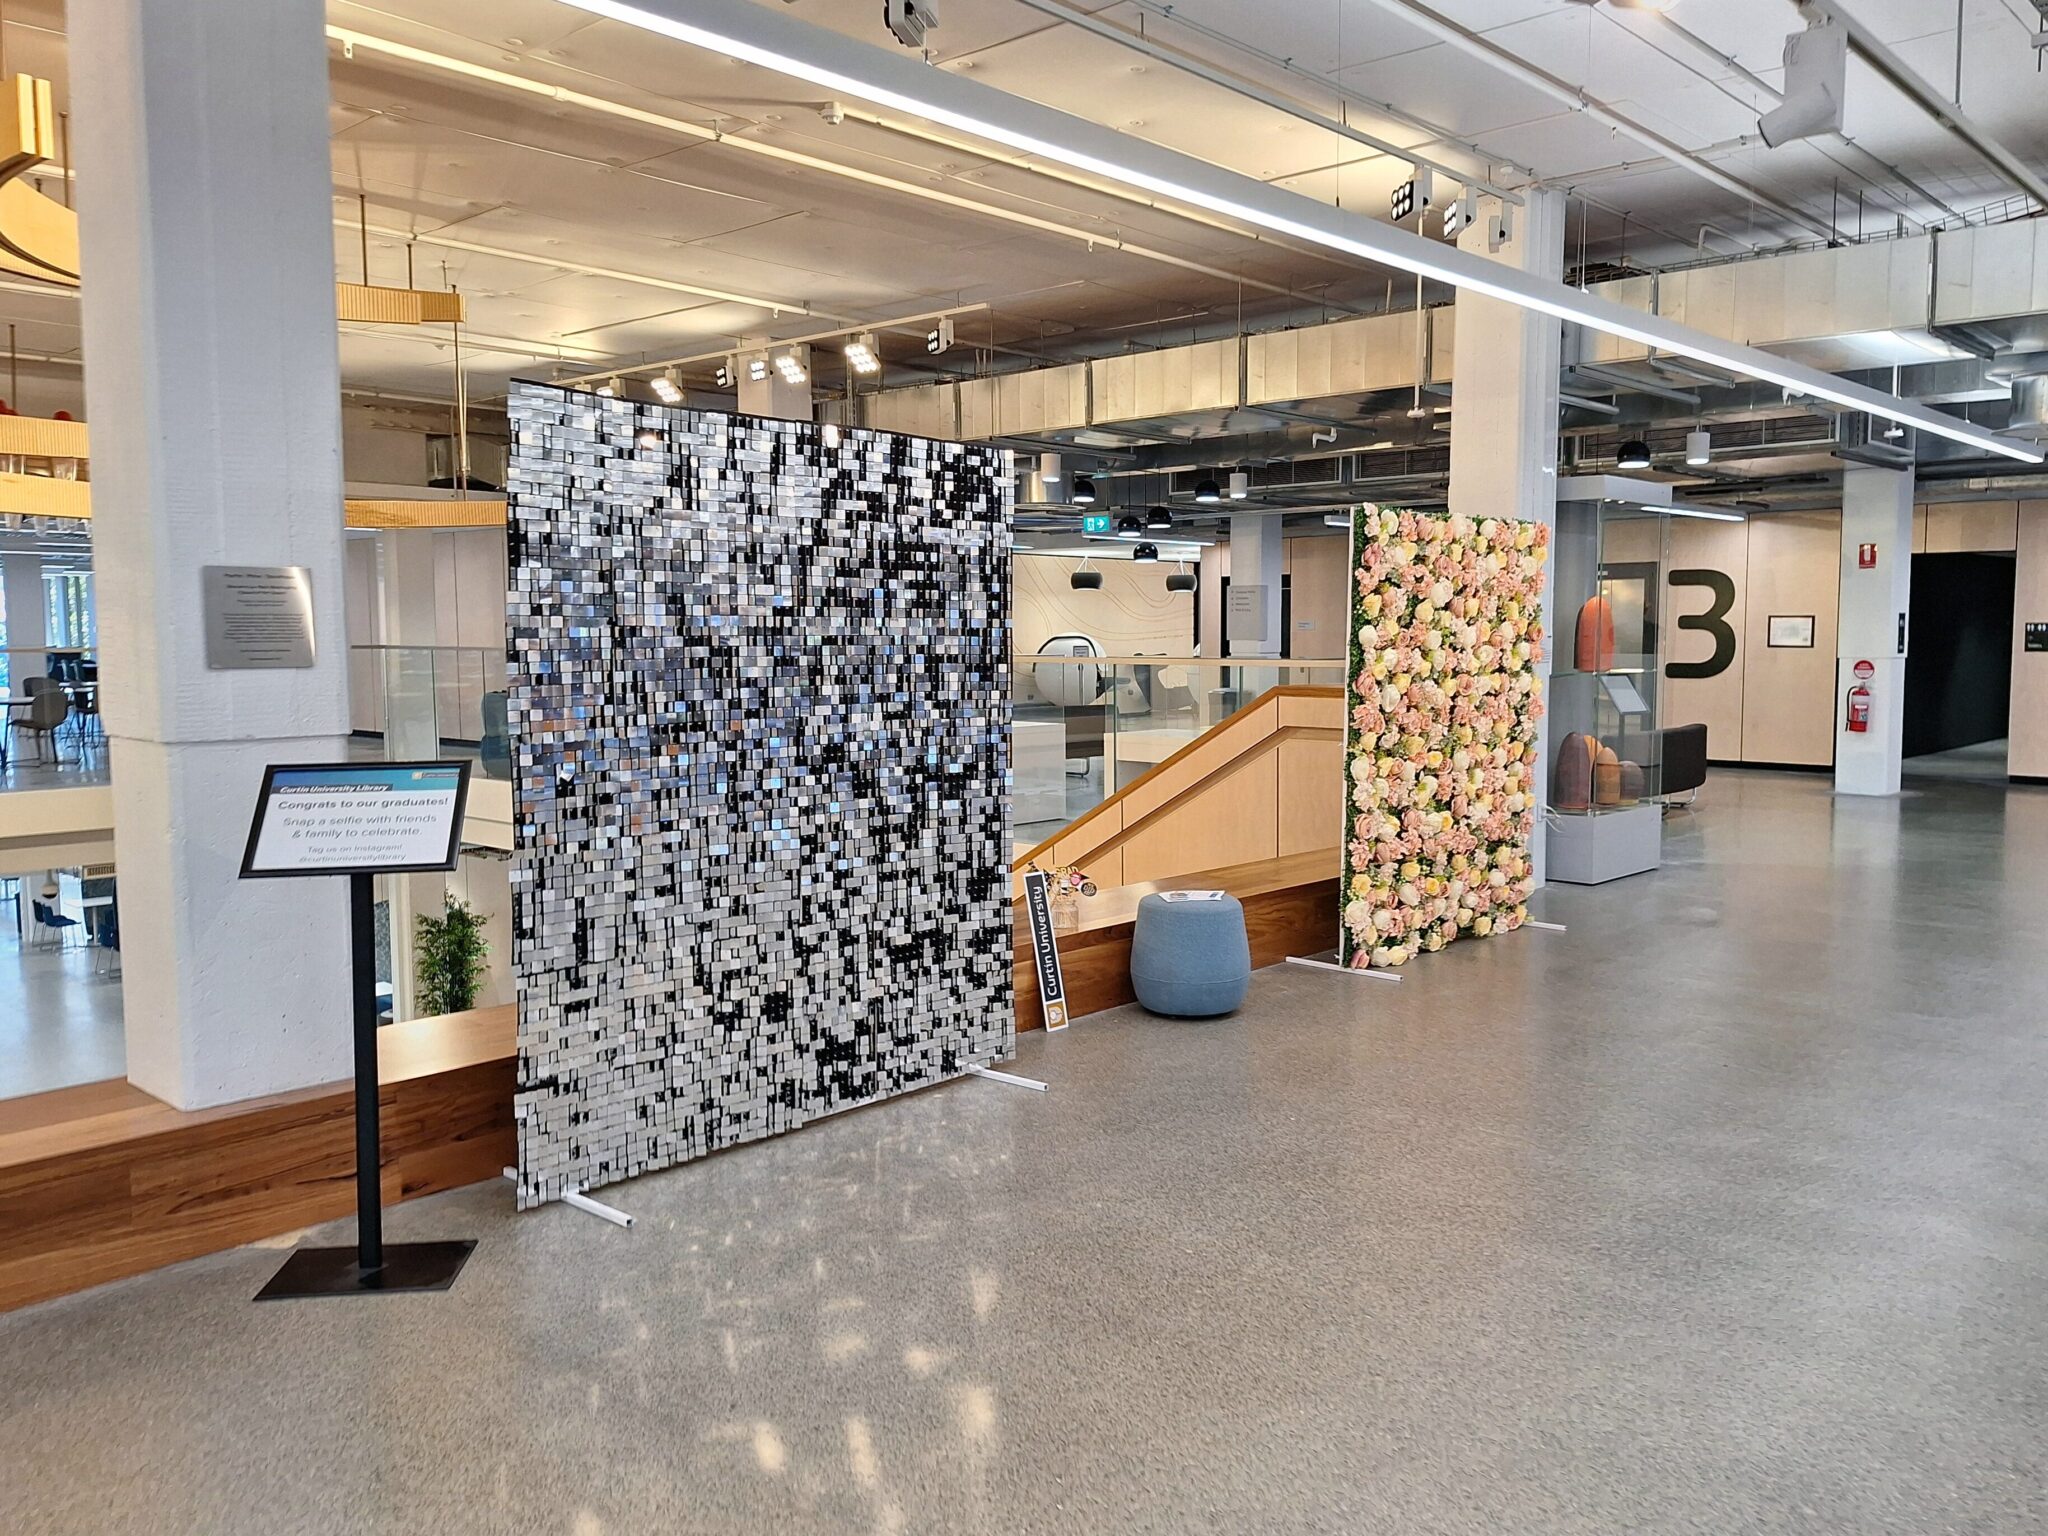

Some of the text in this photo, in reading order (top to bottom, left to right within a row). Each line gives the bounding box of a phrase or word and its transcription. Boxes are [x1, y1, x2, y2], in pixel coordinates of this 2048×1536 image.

[1665, 569, 1736, 679] 3
[309, 785, 356, 793] University
[356, 784, 389, 792] Library
[278, 801, 336, 810] Congrats
[341, 800, 353, 808] to
[381, 797, 449, 808] graduates!
[283, 817, 315, 827] Snap
[329, 815, 363, 825] selfie
[366, 815, 392, 824] with
[395, 814, 437, 823] friends
[291, 827, 423, 839] & family to celebrate.
[308, 846, 325, 854] Tag
[1033, 886, 1058, 996] Curtin University
